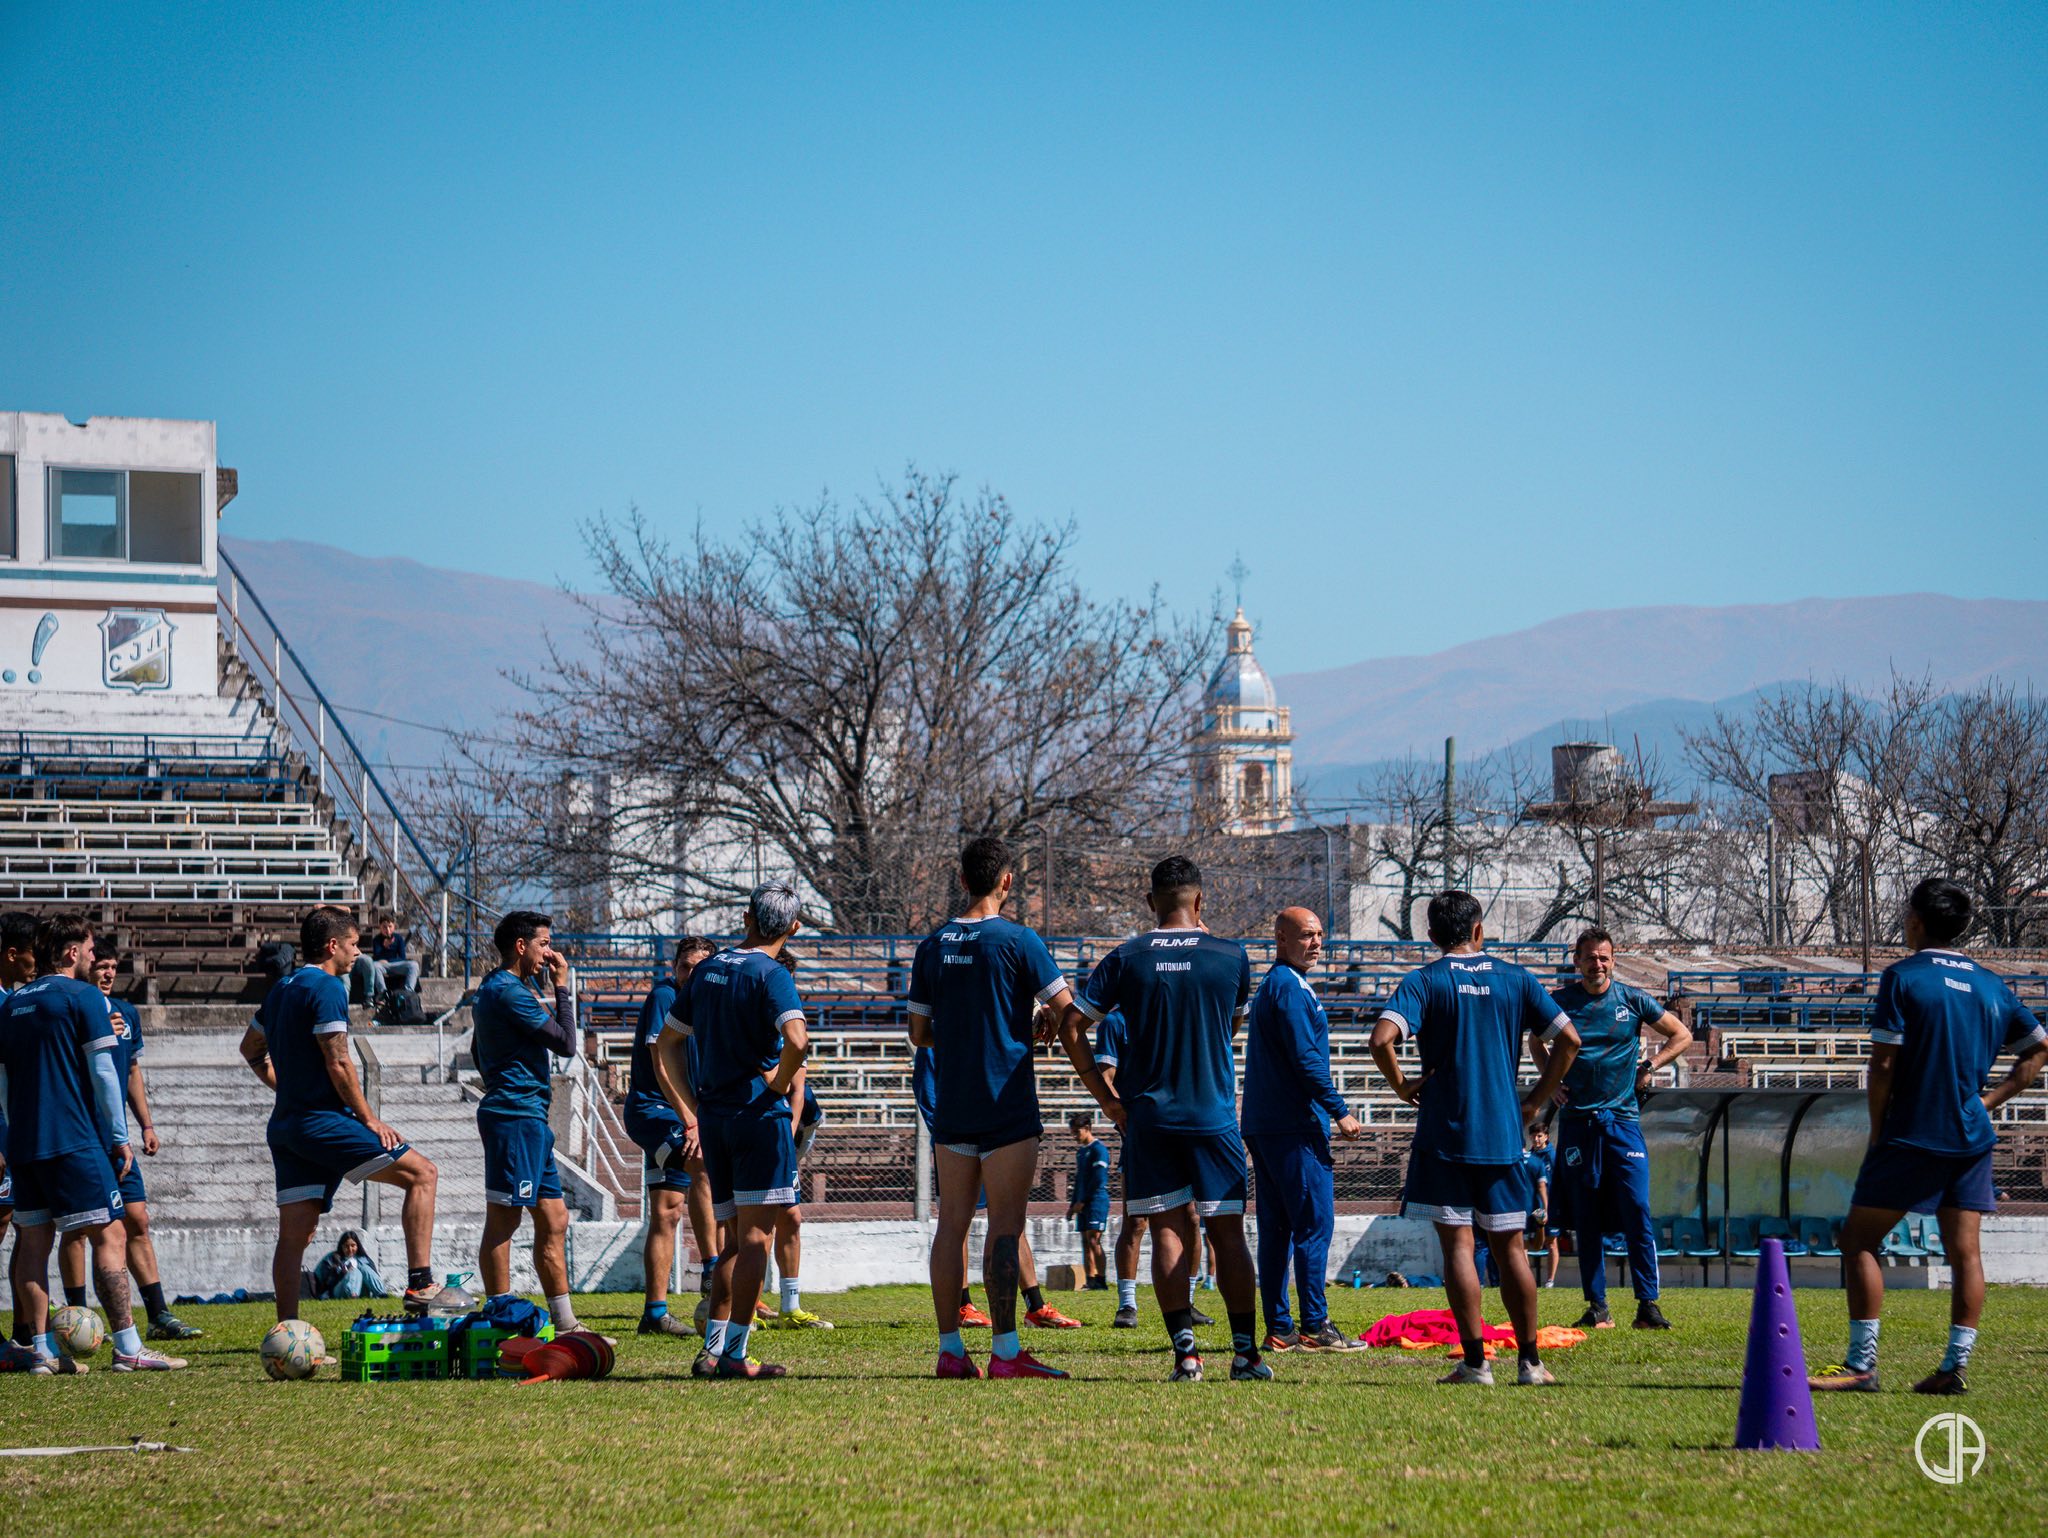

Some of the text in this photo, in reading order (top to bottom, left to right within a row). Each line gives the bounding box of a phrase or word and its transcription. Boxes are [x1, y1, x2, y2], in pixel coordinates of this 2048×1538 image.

[940, 930, 980, 941] FIUME
[1151, 938, 1200, 947] FIUME
[1156, 962, 1191, 972] ANTONIANO
[1450, 962, 1493, 973] FIUME
[1932, 957, 1974, 971] FIUME
